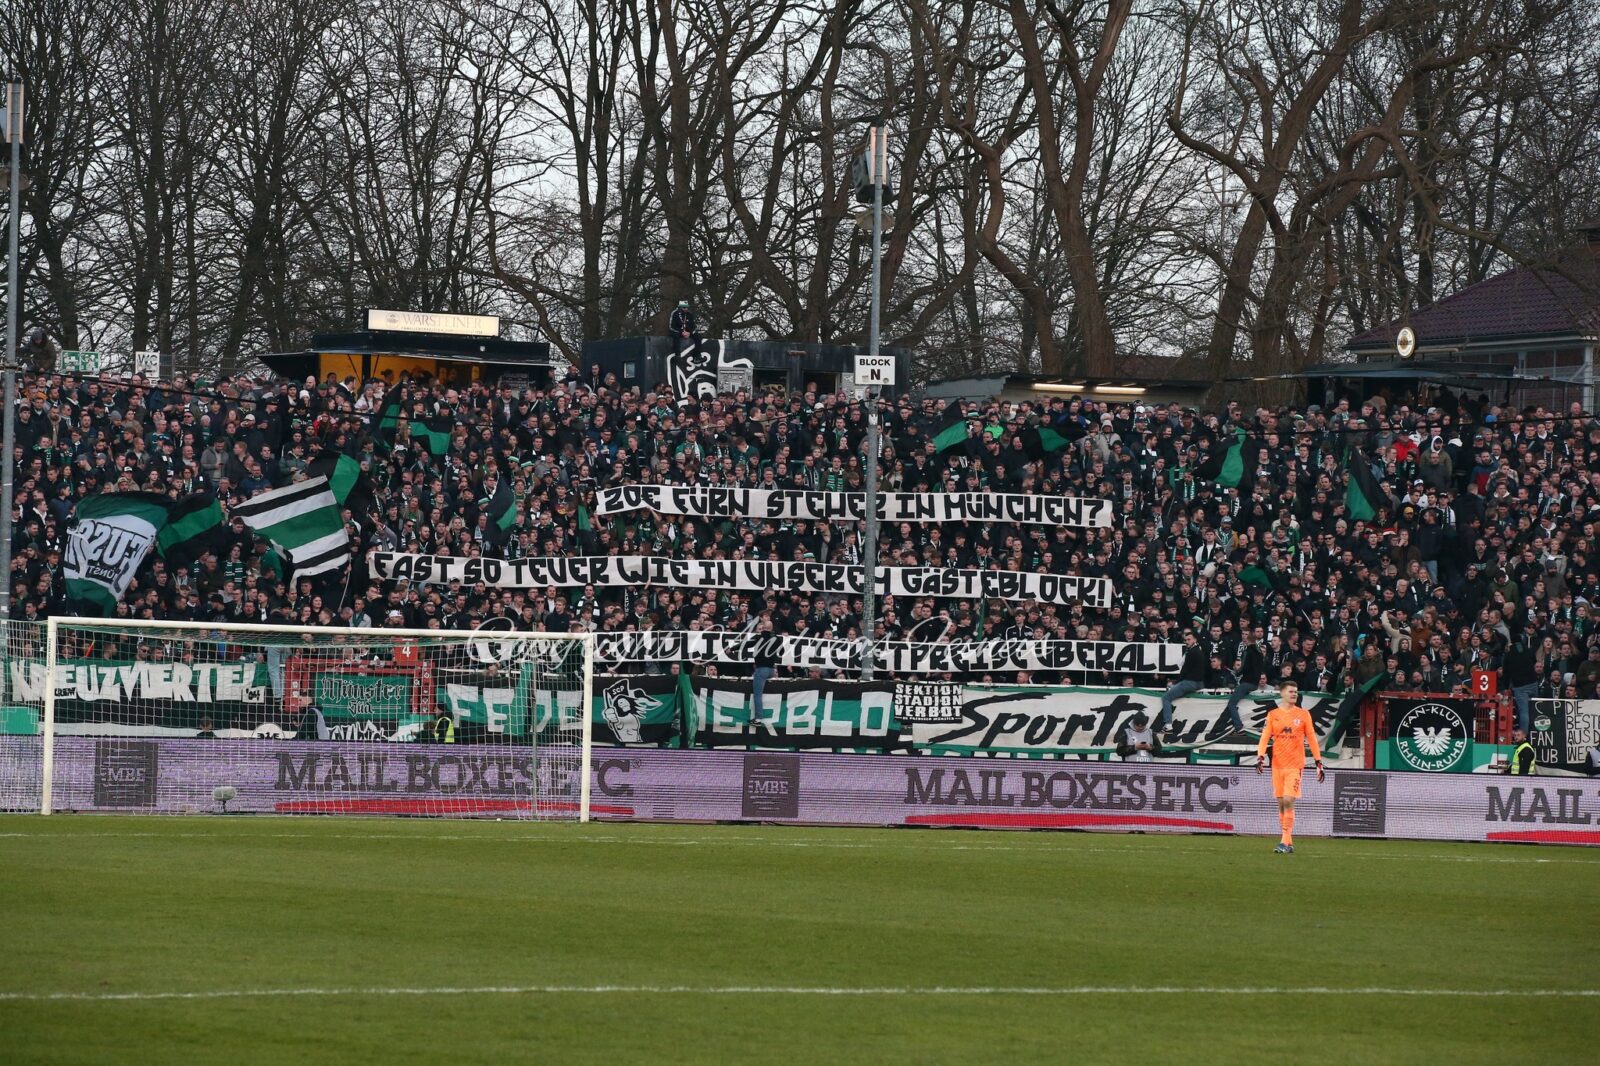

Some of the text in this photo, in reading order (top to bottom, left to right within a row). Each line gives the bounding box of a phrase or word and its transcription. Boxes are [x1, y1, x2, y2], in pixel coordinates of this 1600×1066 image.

[859, 358, 891, 366] BLOCK
[870, 368, 881, 381] N
[672, 487, 750, 516] FÜRN
[895, 493, 936, 519] IN
[944, 493, 1104, 526] MÜNCHEN?
[374, 552, 455, 582] FAST
[464, 557, 501, 585] SO
[508, 558, 610, 585] TEUER
[616, 557, 689, 584] WIE
[699, 561, 737, 588] IN
[902, 567, 1105, 607] GÄSTEBLOCK!
[402, 642, 411, 658] 4
[612, 685, 625, 695] SCP
[895, 683, 963, 695] SEKTION
[1479, 674, 1489, 691] 3
[894, 694, 963, 706] STADION
[1565, 701, 1585, 715] DIE
[894, 704, 963, 717] VERBOT
[1402, 705, 1460, 729] FAN-KLUB
[1530, 731, 1554, 747] FAN
[1399, 740, 1464, 770] RHEIN-RUHR
[1534, 748, 1559, 764] LUB
[274, 752, 397, 792] MAIL
[405, 755, 540, 795] BOXES
[904, 768, 1233, 814] MAIL BOXES ETC.
[1486, 786, 1591, 825] MAIL
